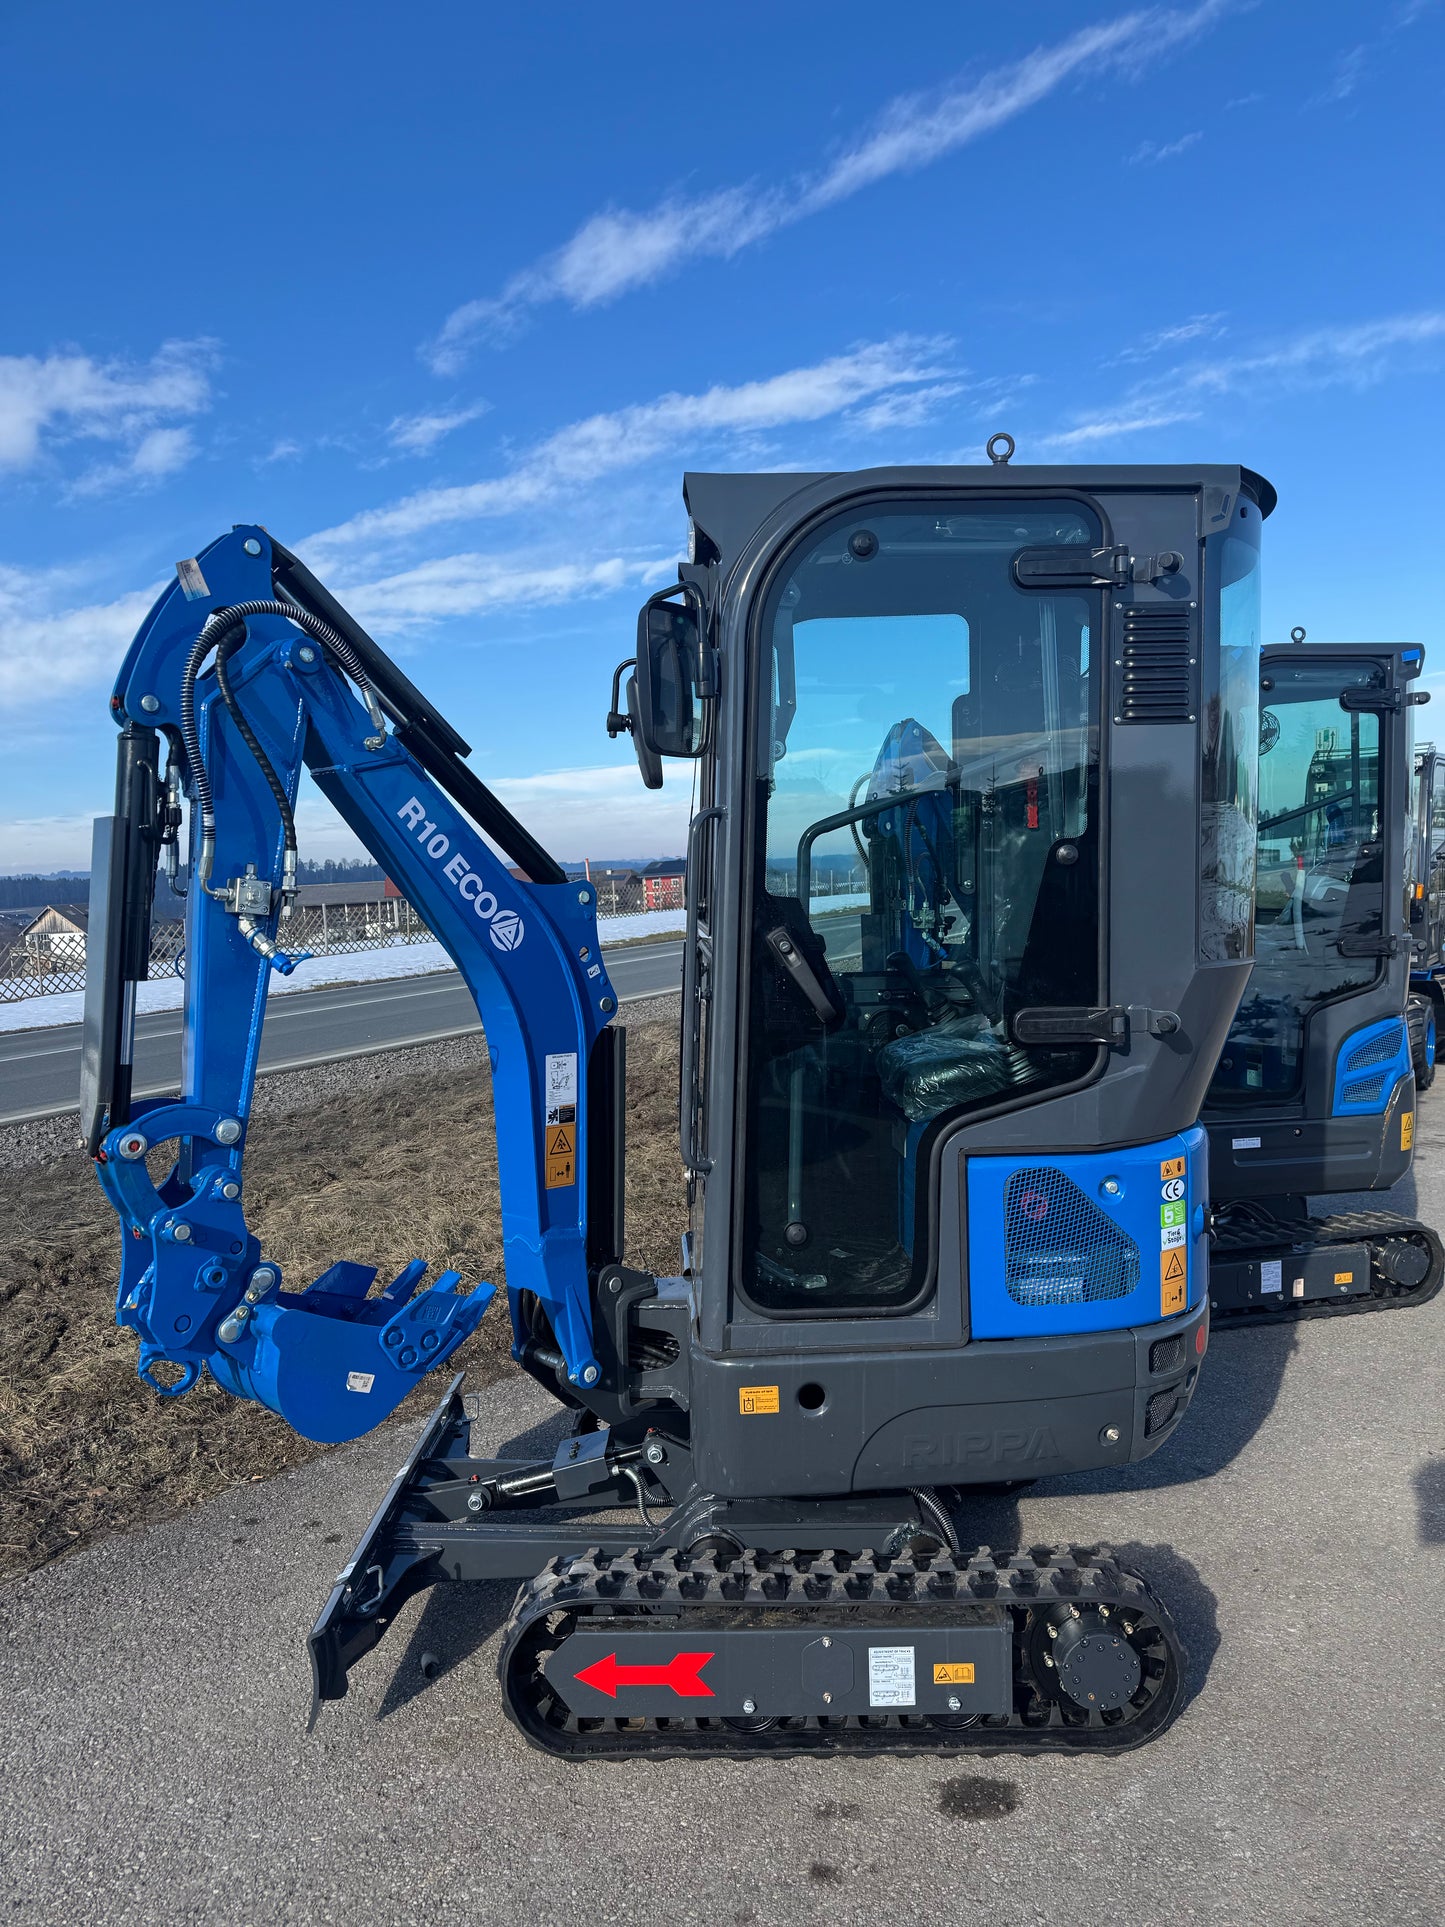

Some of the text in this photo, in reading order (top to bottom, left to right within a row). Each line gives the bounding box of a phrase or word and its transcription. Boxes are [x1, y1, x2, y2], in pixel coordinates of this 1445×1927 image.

[397, 796, 498, 919] R10 ECO
[1165, 1180, 1180, 1200] CE
[903, 1426, 1062, 1467] RIPPA
